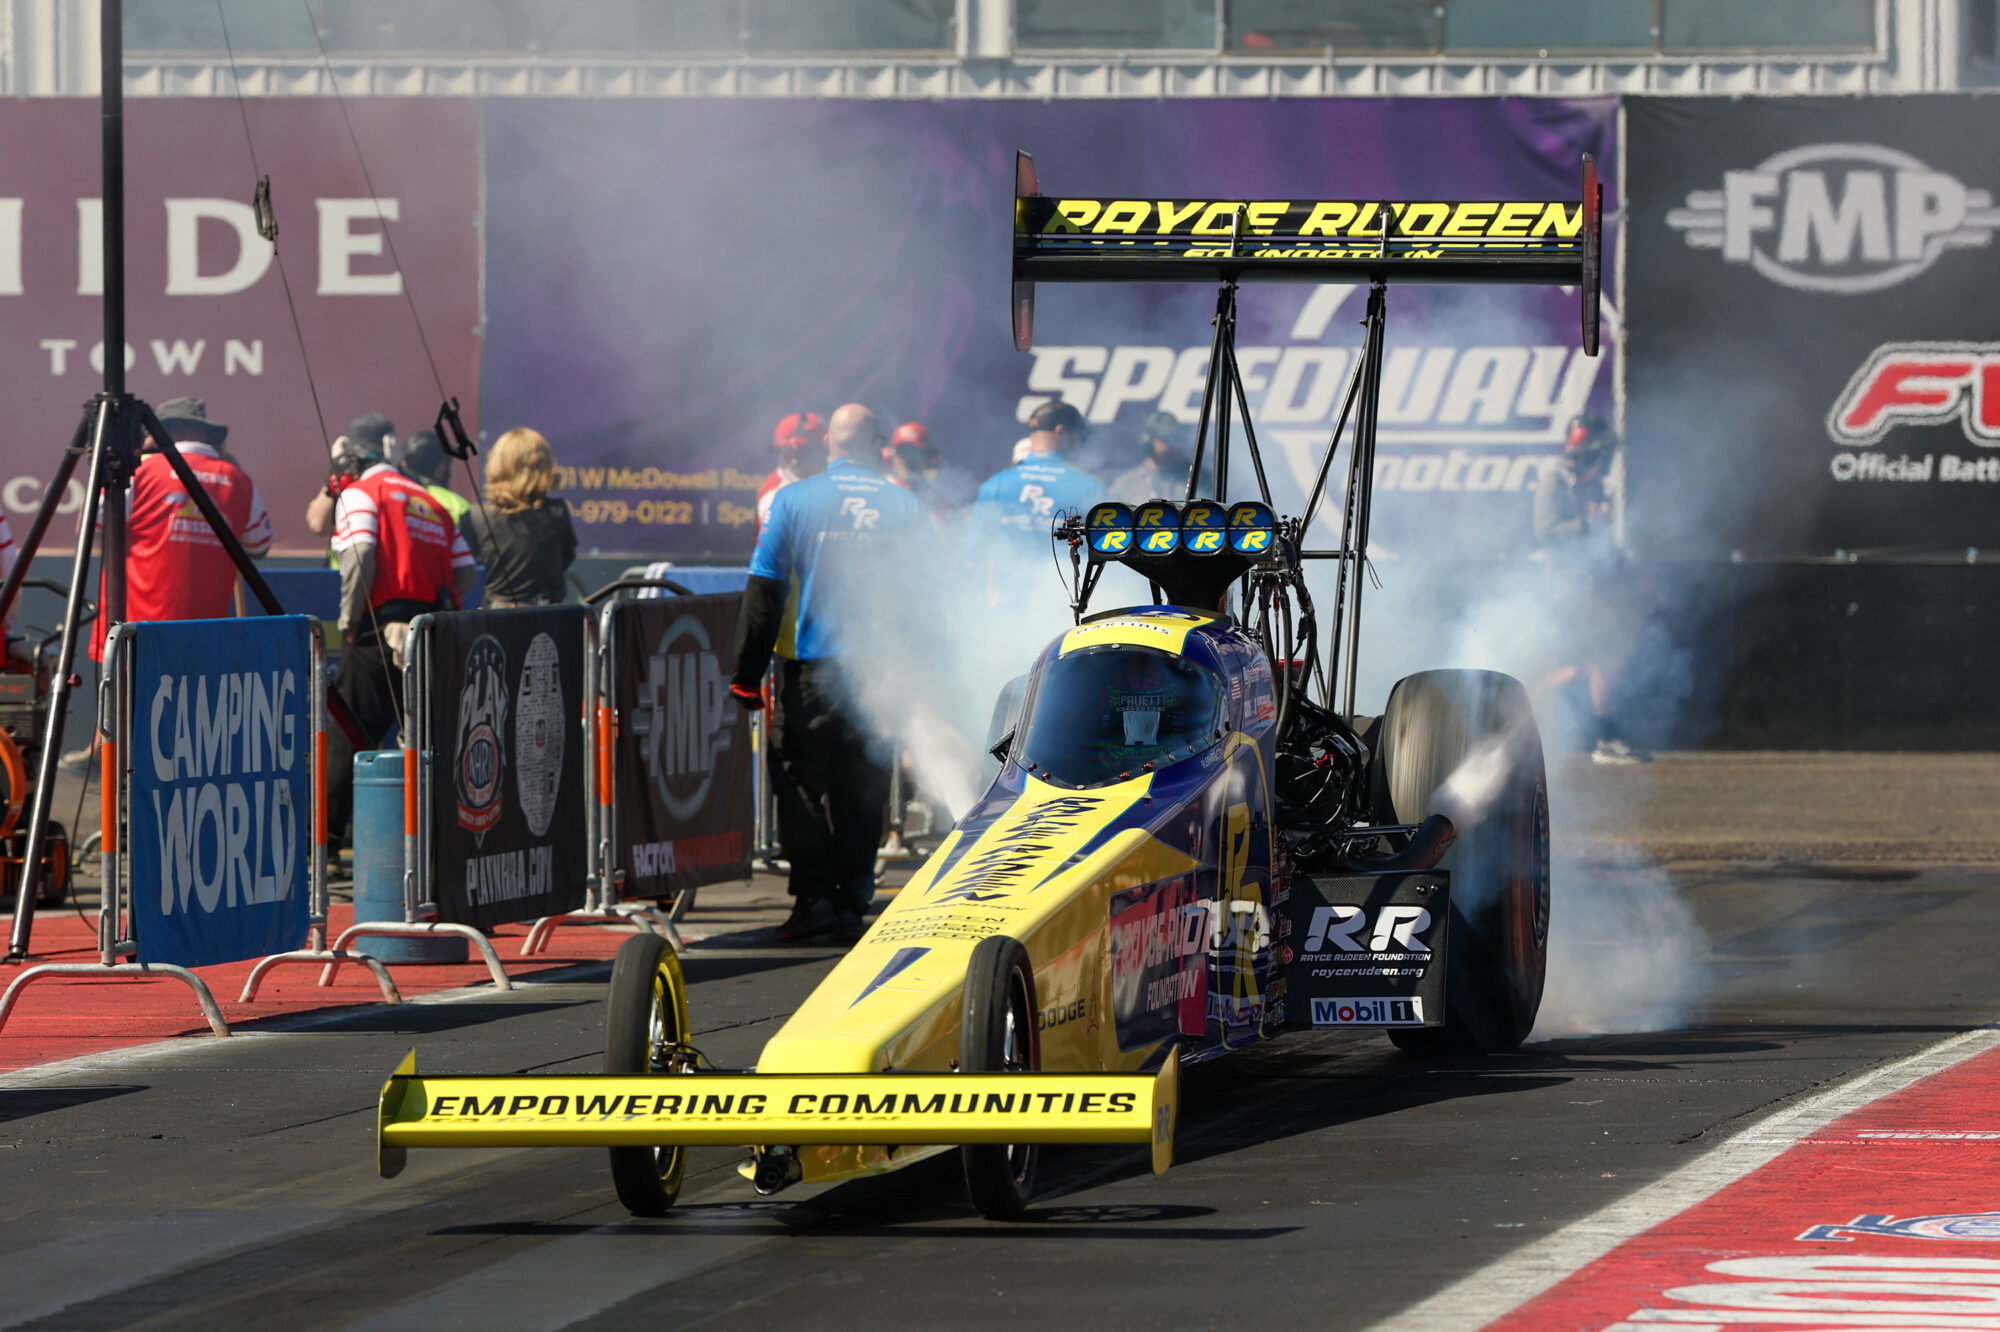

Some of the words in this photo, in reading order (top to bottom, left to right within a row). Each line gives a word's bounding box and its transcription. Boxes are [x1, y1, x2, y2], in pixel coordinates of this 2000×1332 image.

[1043, 200, 1291, 236] RAYCE
[1299, 202, 1583, 238] RUDEEN
[1723, 170, 1966, 264] FMP
[0, 197, 402, 296] IDE
[40, 339, 264, 376] TOWN
[1016, 346, 1602, 438] SPEEDWAY
[578, 468, 605, 488] W
[1831, 453, 1934, 481] Official
[1939, 454, 2000, 482] Batt
[2, 475, 86, 515] CO
[1102, 531, 1127, 549] R
[1148, 531, 1173, 549] R
[1195, 531, 1220, 549] R
[1242, 531, 1266, 549] R
[649, 652, 724, 777] FMP
[1120, 695, 1162, 706] PRUETT
[151, 668, 295, 782] CAMPING
[152, 779, 296, 916] WORLD
[466, 845, 553, 907] PLAYNHRA.COM
[1304, 906, 1431, 952] RR
[1300, 954, 1332, 962] RAYCE
[1334, 953, 1370, 961] RUDEEN
[1372, 953, 1431, 961] FOUNDATION
[1311, 966, 1424, 979] raycerudeen.org
[1146, 969, 1199, 1012] FOUNDATION
[1039, 998, 1086, 1031] DODGE
[1314, 1001, 1386, 1022] Mobil
[430, 1094, 768, 1116] EMPOWERING
[788, 1093, 1137, 1113] COMMUNITIES
